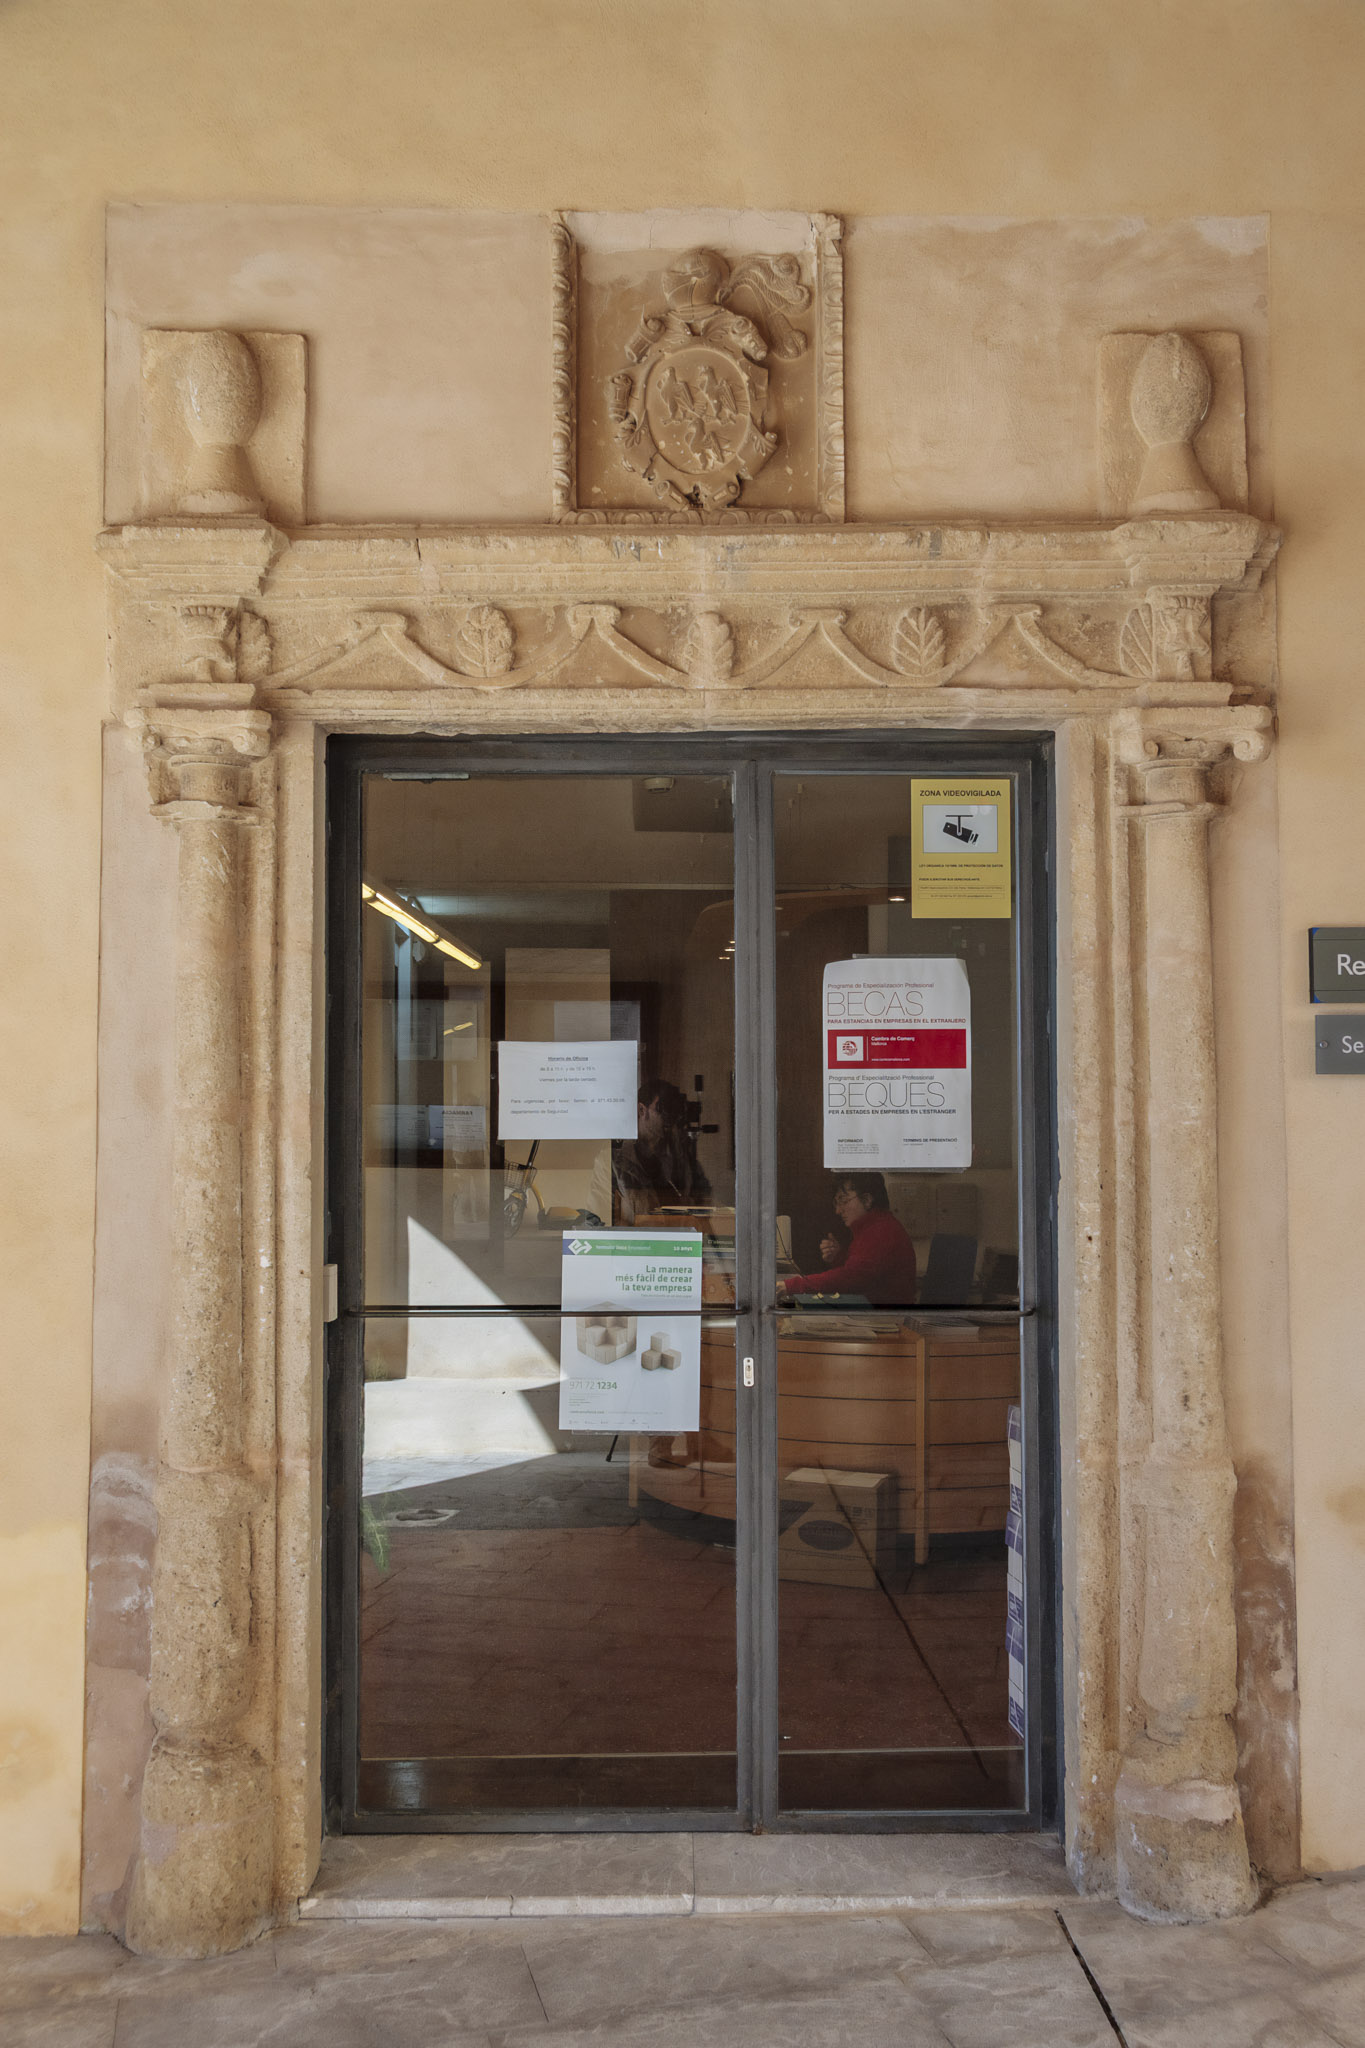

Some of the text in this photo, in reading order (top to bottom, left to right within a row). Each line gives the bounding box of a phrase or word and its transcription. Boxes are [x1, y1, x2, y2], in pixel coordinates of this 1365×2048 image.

[1337, 954, 1365, 976] Re
[827, 990, 924, 1016] BECAS
[1342, 1036, 1364, 1054] Se
[828, 1082, 945, 1107] BEQUES
[636, 1274, 655, 1282] fàcil
[654, 1285, 692, 1293] empresa
[597, 1381, 618, 1389] 1234
